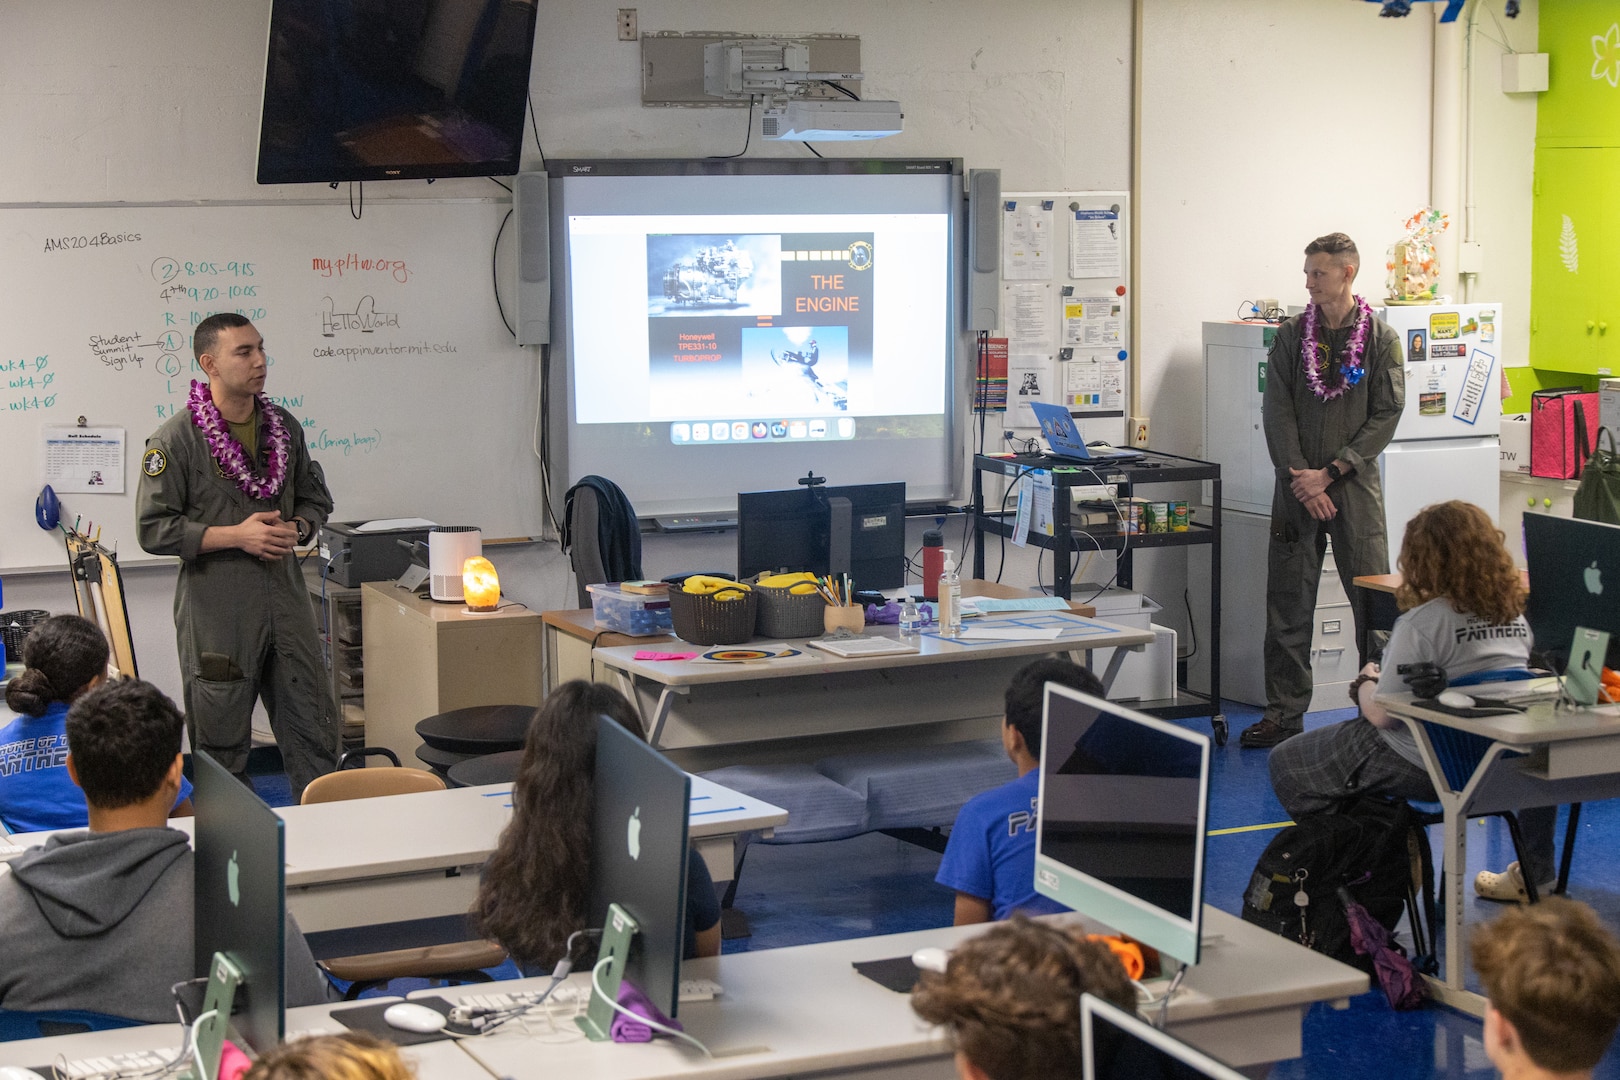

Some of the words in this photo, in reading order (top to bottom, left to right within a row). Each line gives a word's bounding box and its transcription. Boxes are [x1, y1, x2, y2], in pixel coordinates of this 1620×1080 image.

[572, 165, 592, 173] SMART
[811, 274, 845, 290] THE
[795, 296, 860, 313] ENGINE
[88, 332, 141, 347] Student
[679, 333, 715, 342] Honeywell
[92, 343, 133, 356] Summit
[678, 343, 717, 351] TPE331-10
[101, 355, 128, 371] Sign
[673, 354, 722, 363] TURBOPROP
[1455, 622, 1528, 645] PANTHERS
[38, 735, 58, 748] OF
